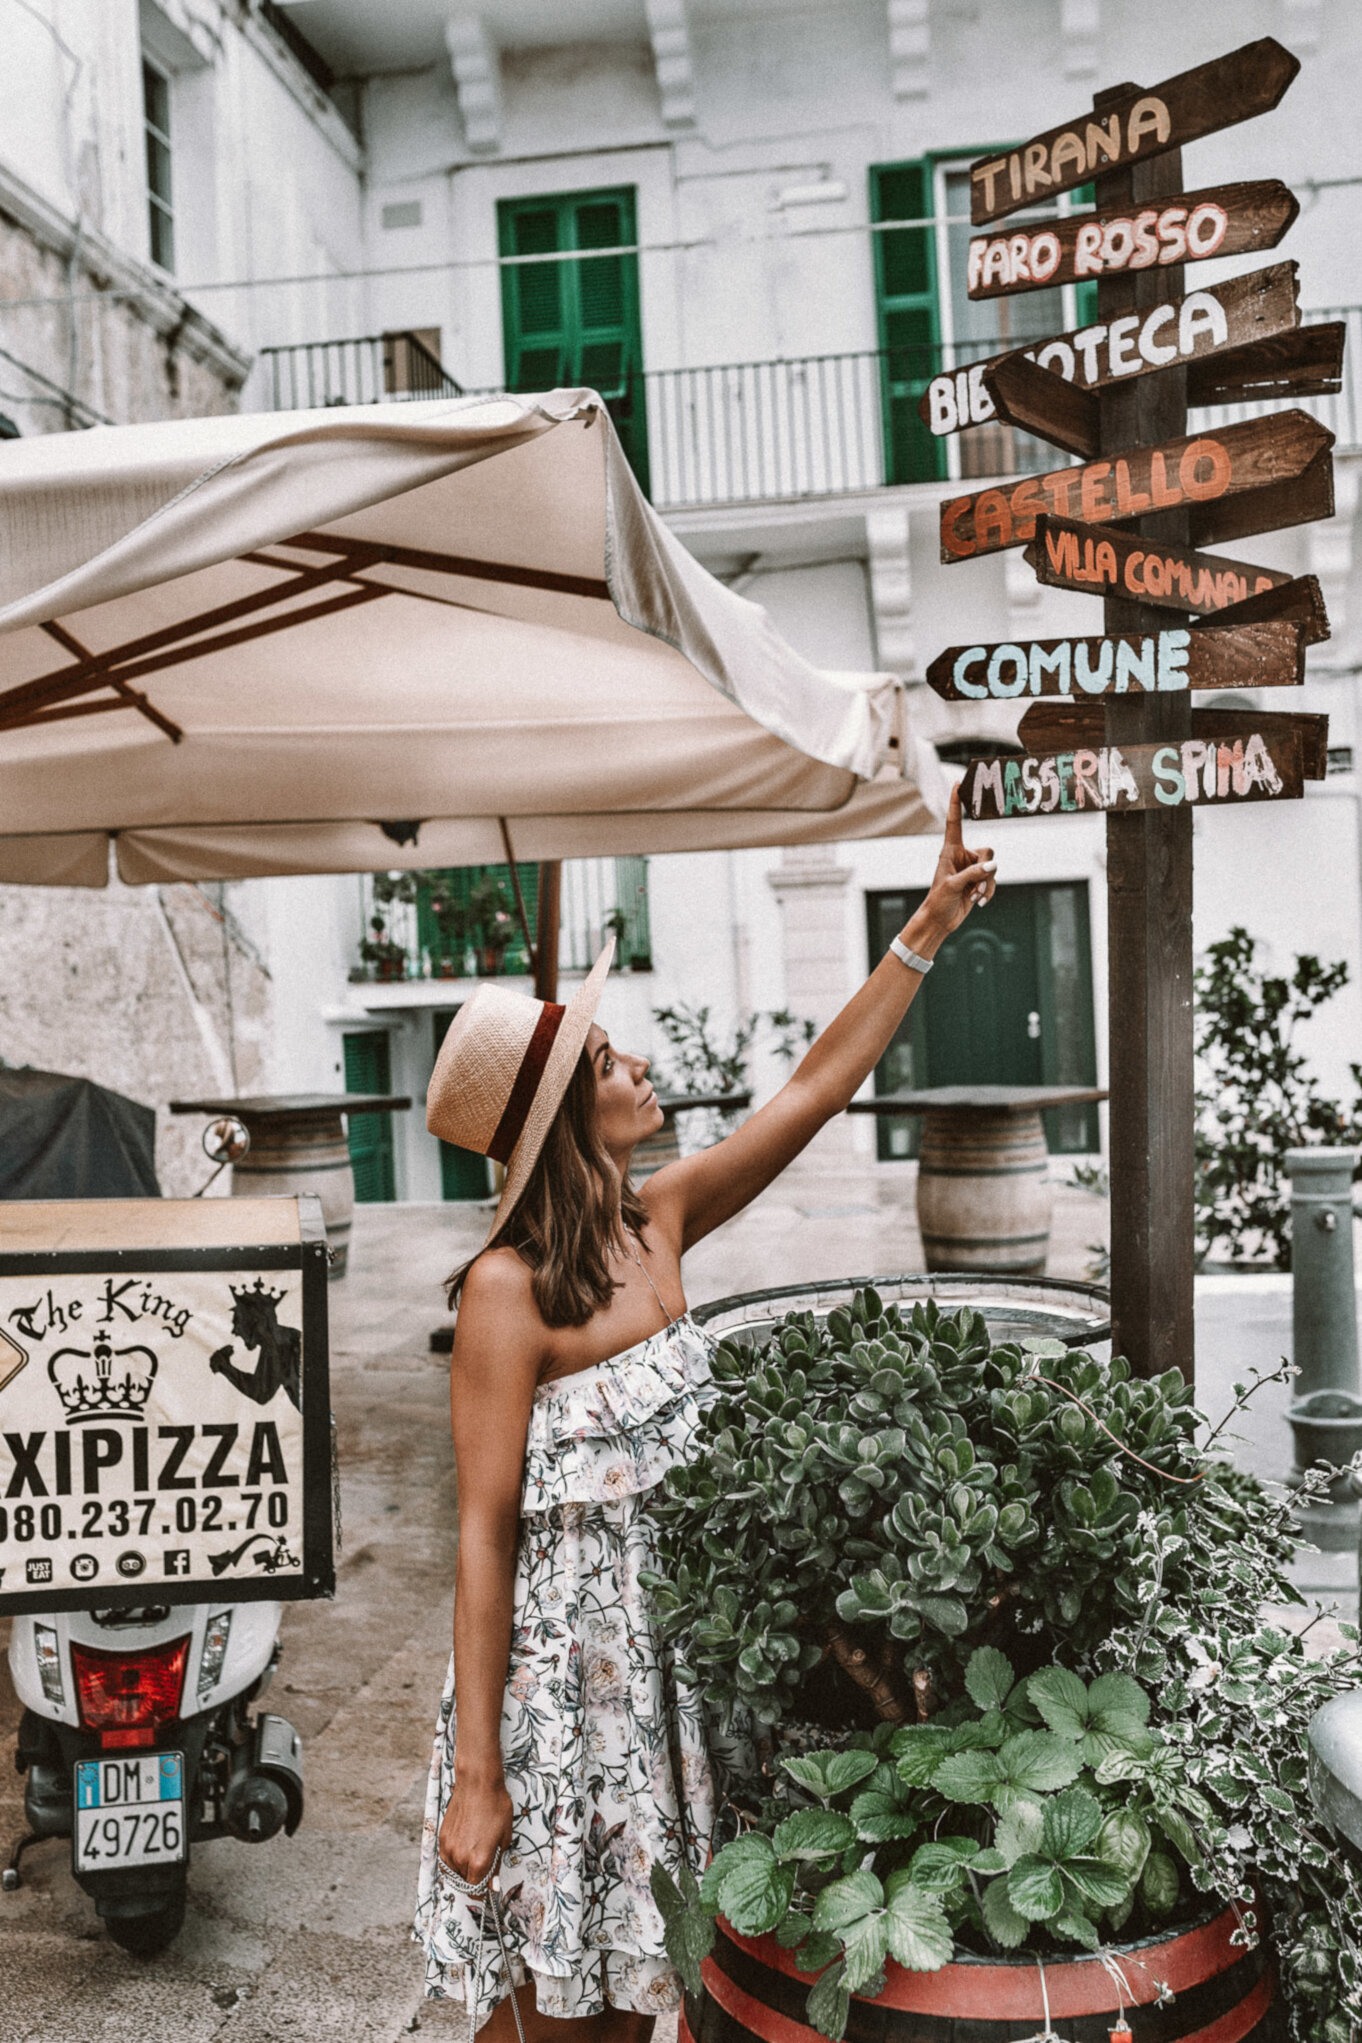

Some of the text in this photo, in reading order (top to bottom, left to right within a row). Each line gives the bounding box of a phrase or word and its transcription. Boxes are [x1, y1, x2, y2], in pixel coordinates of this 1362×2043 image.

[972, 97, 1171, 212] TIRANA
[968, 203, 1228, 292] FARO ROSSO
[929, 292, 1229, 436] BIBOTECA
[941, 439, 1232, 555] CASTELLO
[1045, 530, 1117, 584] VILLA
[953, 629, 1191, 699] COMUNE
[972, 734, 1283, 817] MASSERIA SPINA
[8, 1278, 194, 1341] The King
[27, 1562, 50, 1572] JUST
[33, 1569, 50, 1579] EAT
[104, 1762, 141, 1803] DM
[83, 1811, 180, 1860] 49726
